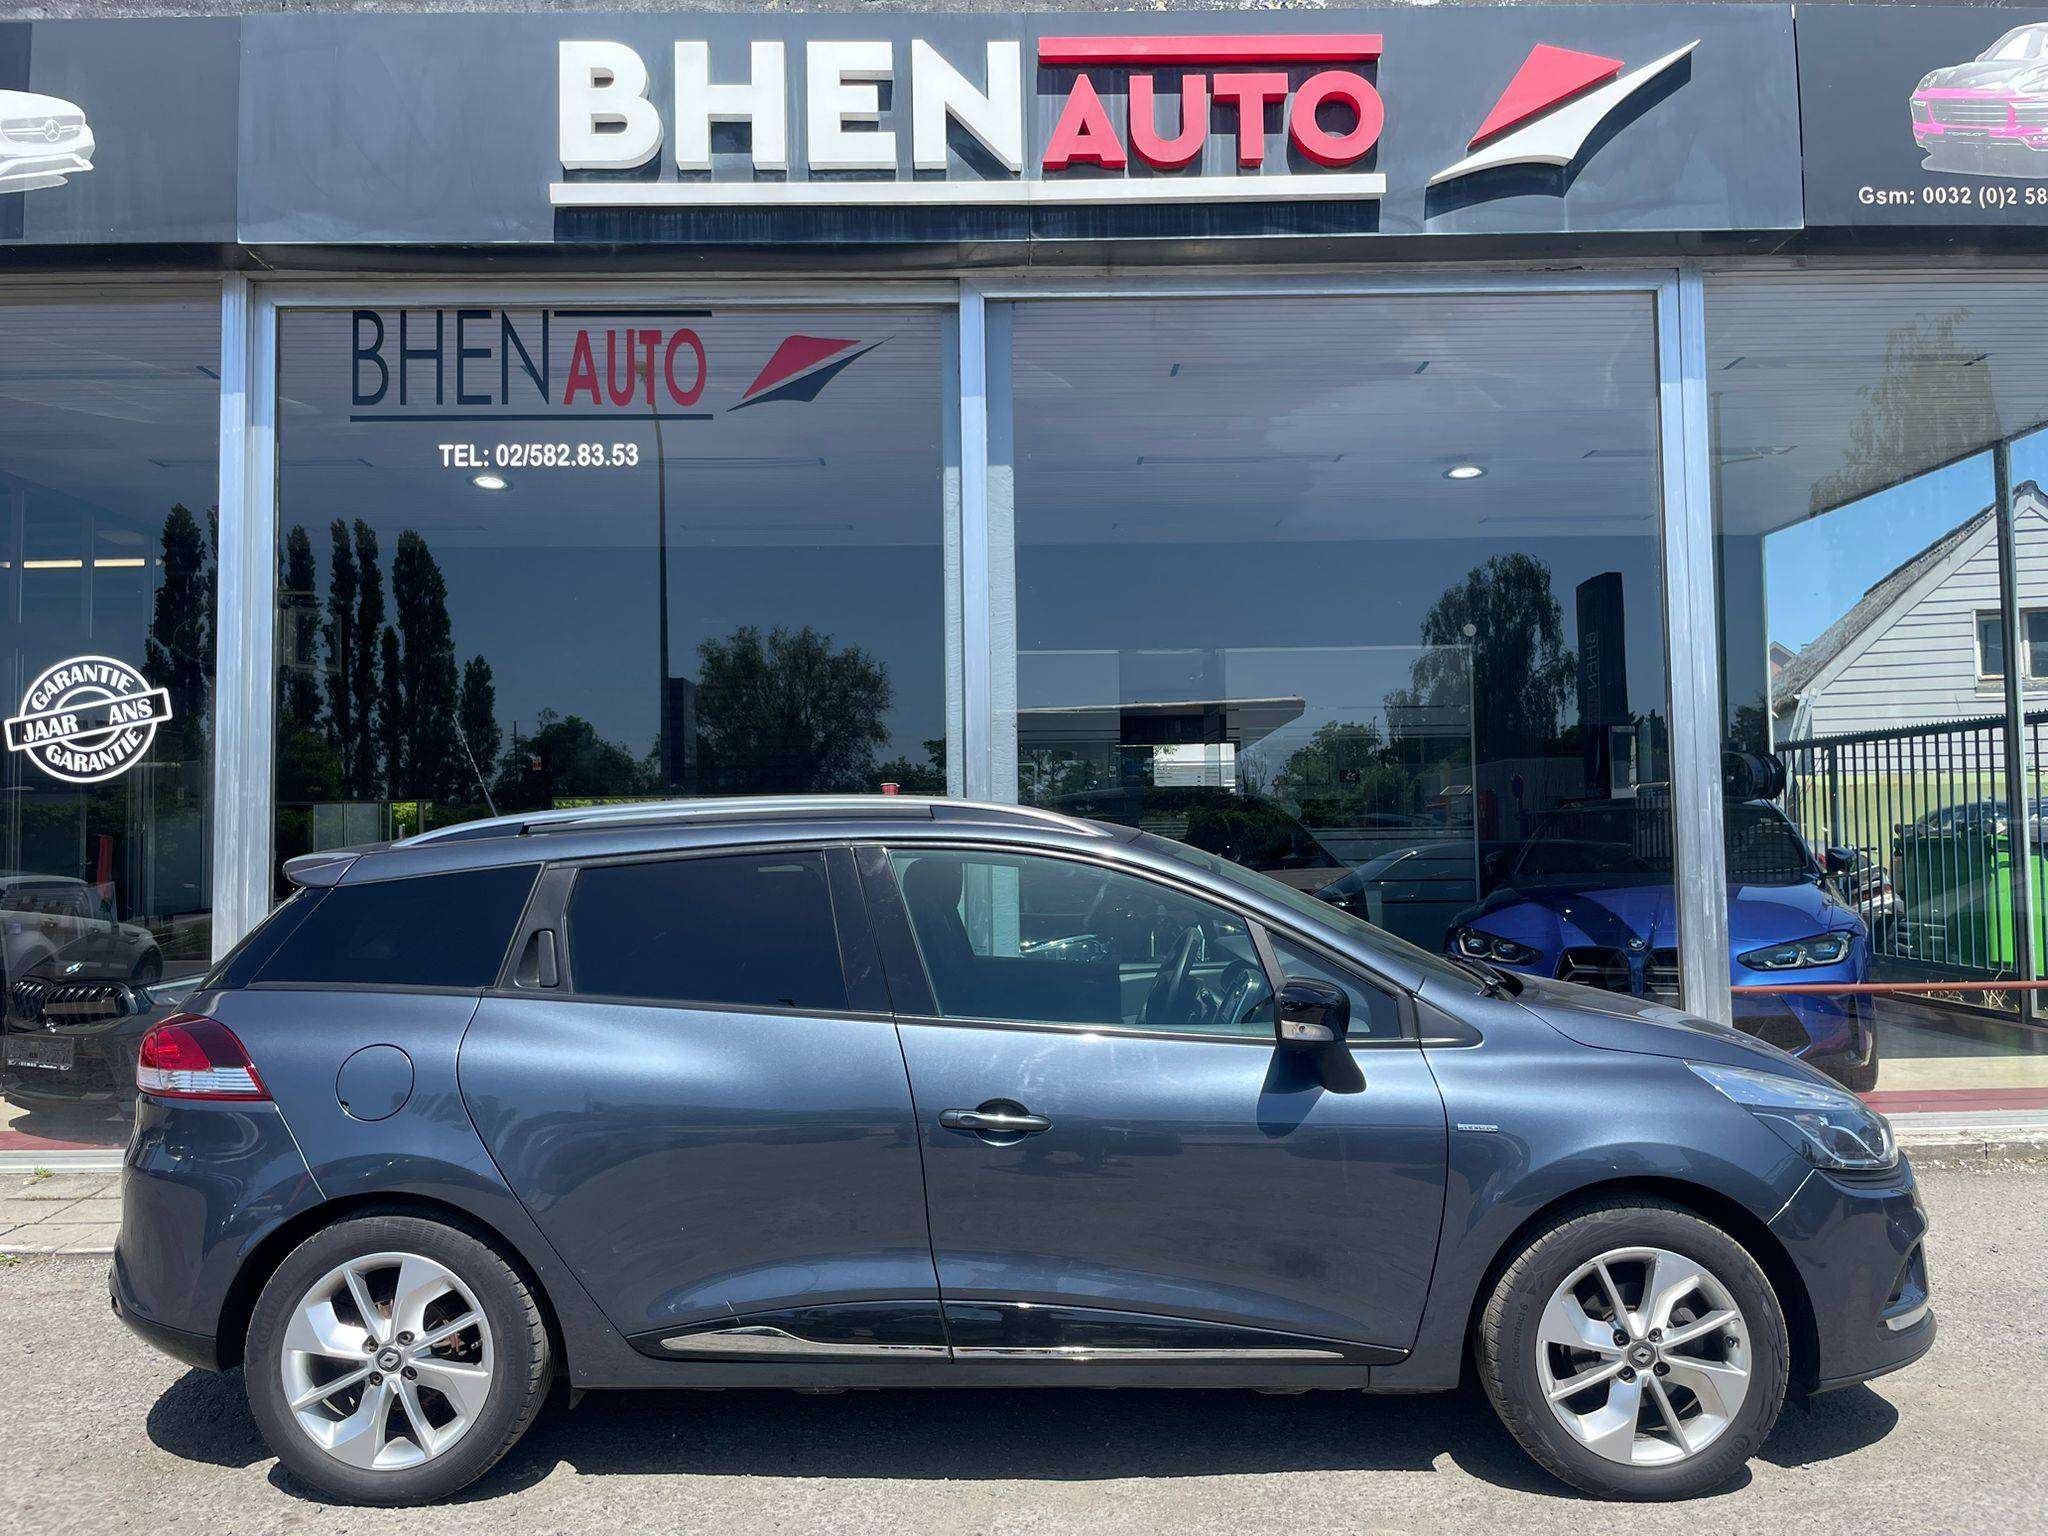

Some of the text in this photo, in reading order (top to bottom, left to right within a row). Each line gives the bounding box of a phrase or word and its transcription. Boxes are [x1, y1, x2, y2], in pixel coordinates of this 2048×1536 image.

[558, 39, 1385, 172] BHEN AUTO
[1858, 186, 2048, 209] Gsm: 0032 (0)2 58
[351, 309, 708, 406] BHEN AUTO
[438, 442, 639, 468] TEL: 02/582.83.53
[31, 664, 135, 711] GARANTIE
[23, 698, 153, 743] JAAR ANS
[45, 725, 144, 772] GARANTIE
